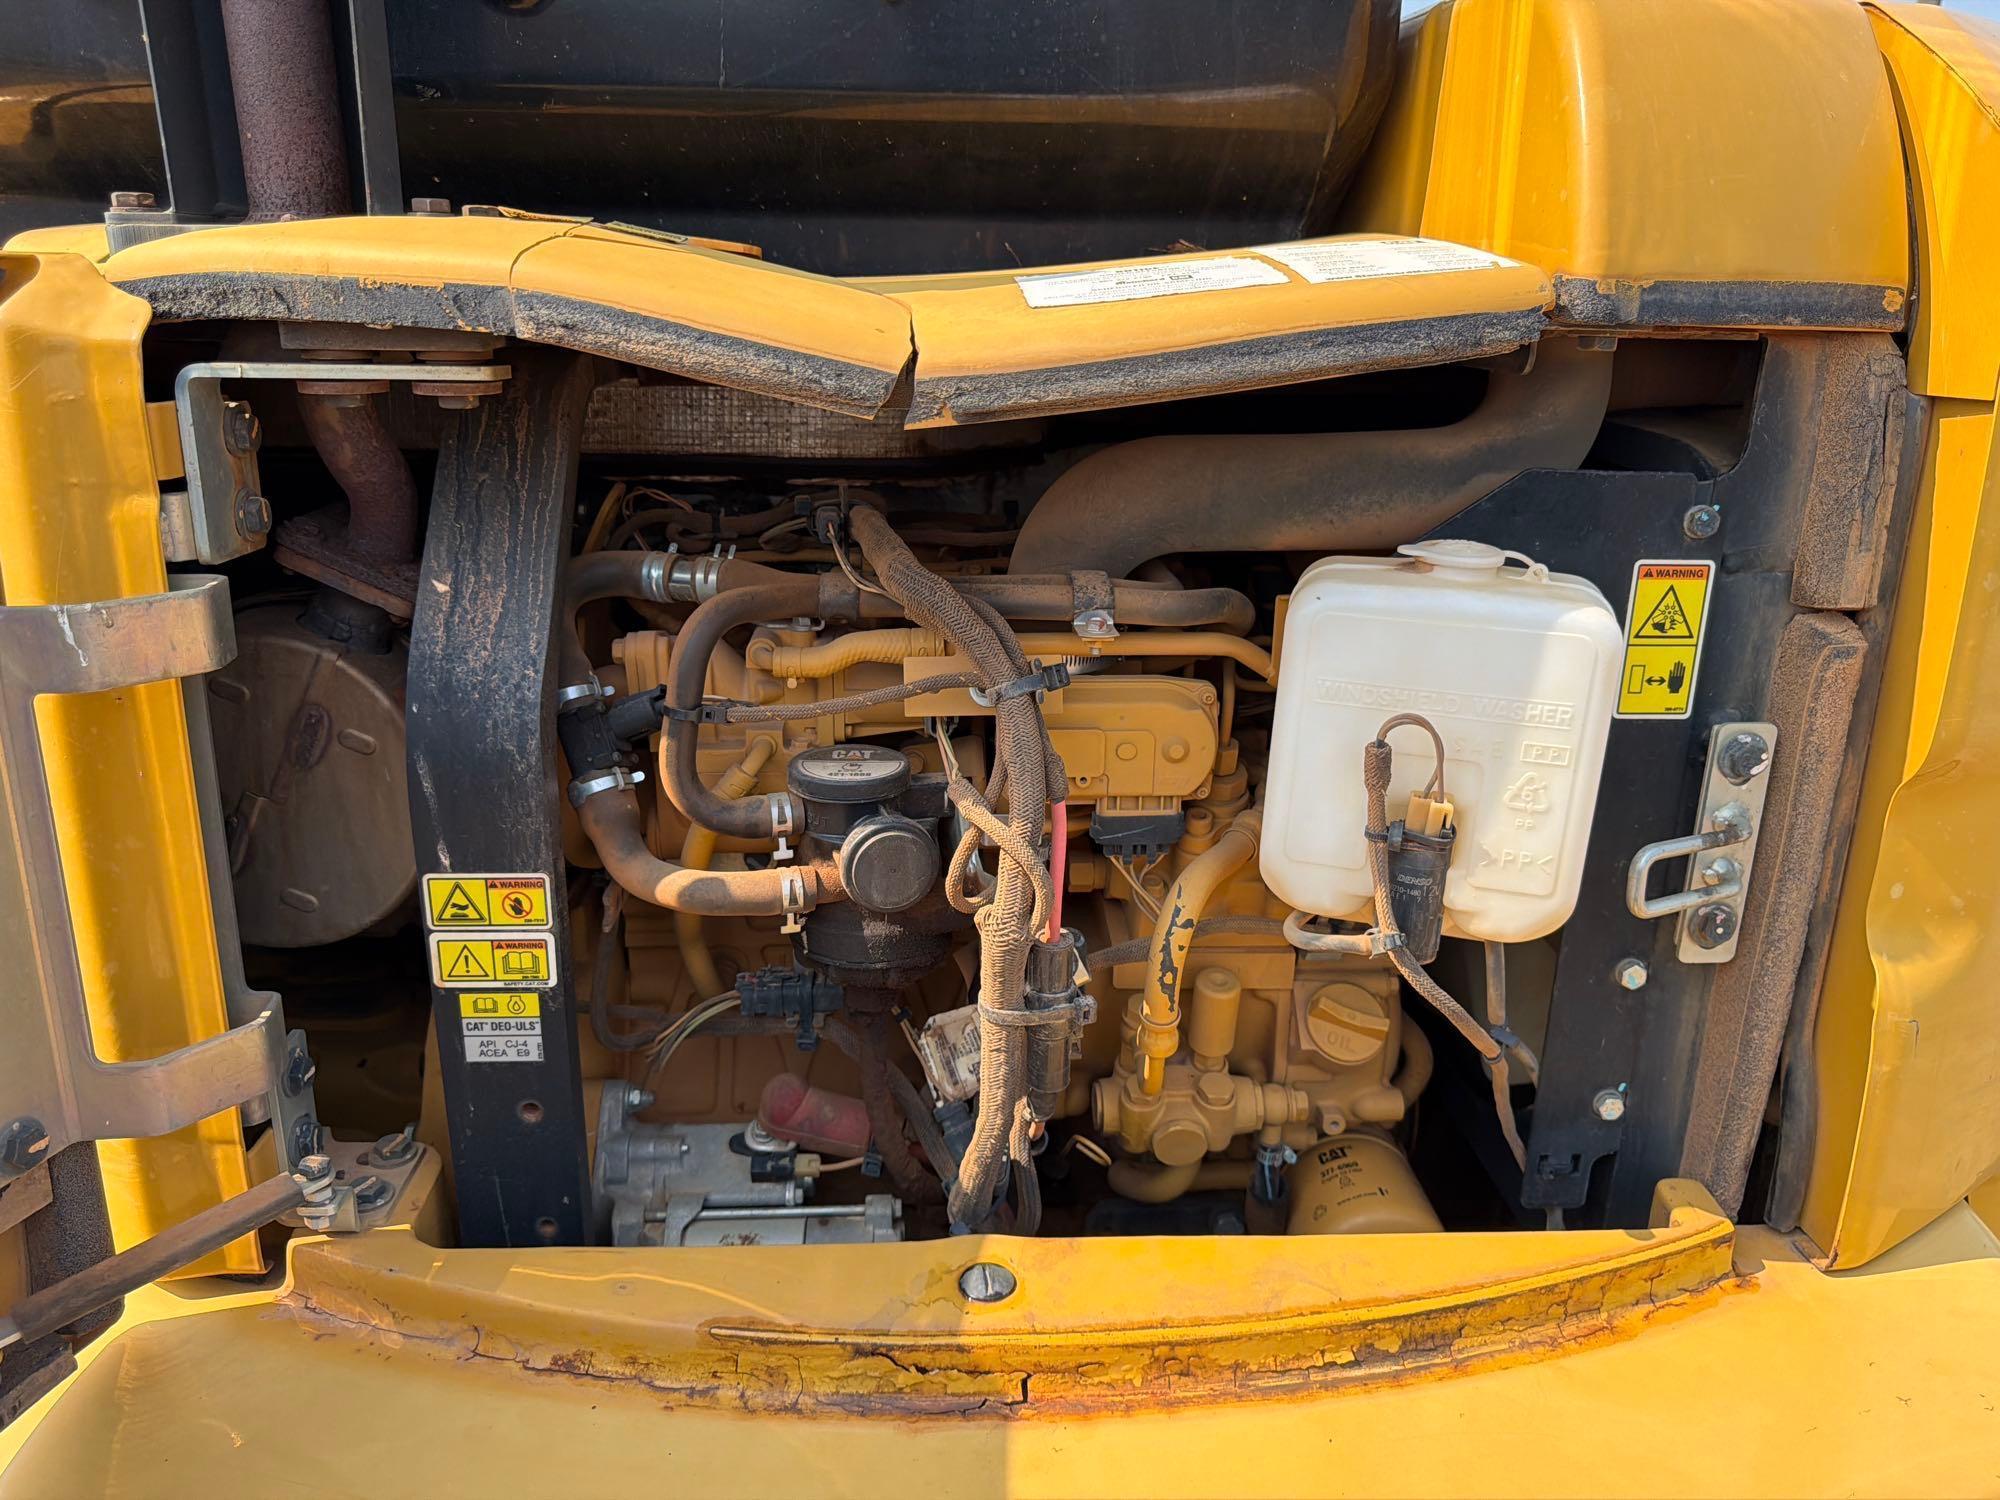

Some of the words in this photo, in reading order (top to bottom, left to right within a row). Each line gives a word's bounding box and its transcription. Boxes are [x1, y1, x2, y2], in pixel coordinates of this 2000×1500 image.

[1655, 568, 1704, 578] WARNING
[1317, 679, 1459, 713] WINDSHIELD
[1473, 696, 1573, 724] WASHER
[832, 750, 874, 759] CAT
[499, 881, 544, 889] WARNING
[1397, 874, 1433, 886] DENSO
[491, 1021, 536, 1032] DEO-ULS
[479, 1040, 497, 1048] API
[505, 1039, 529, 1048] CJ-4
[1327, 1031, 1358, 1056] OIL
[479, 1048, 509, 1057] ACEA
[516, 1048, 531, 1057] E9
[1317, 1146, 1348, 1165] CAT
